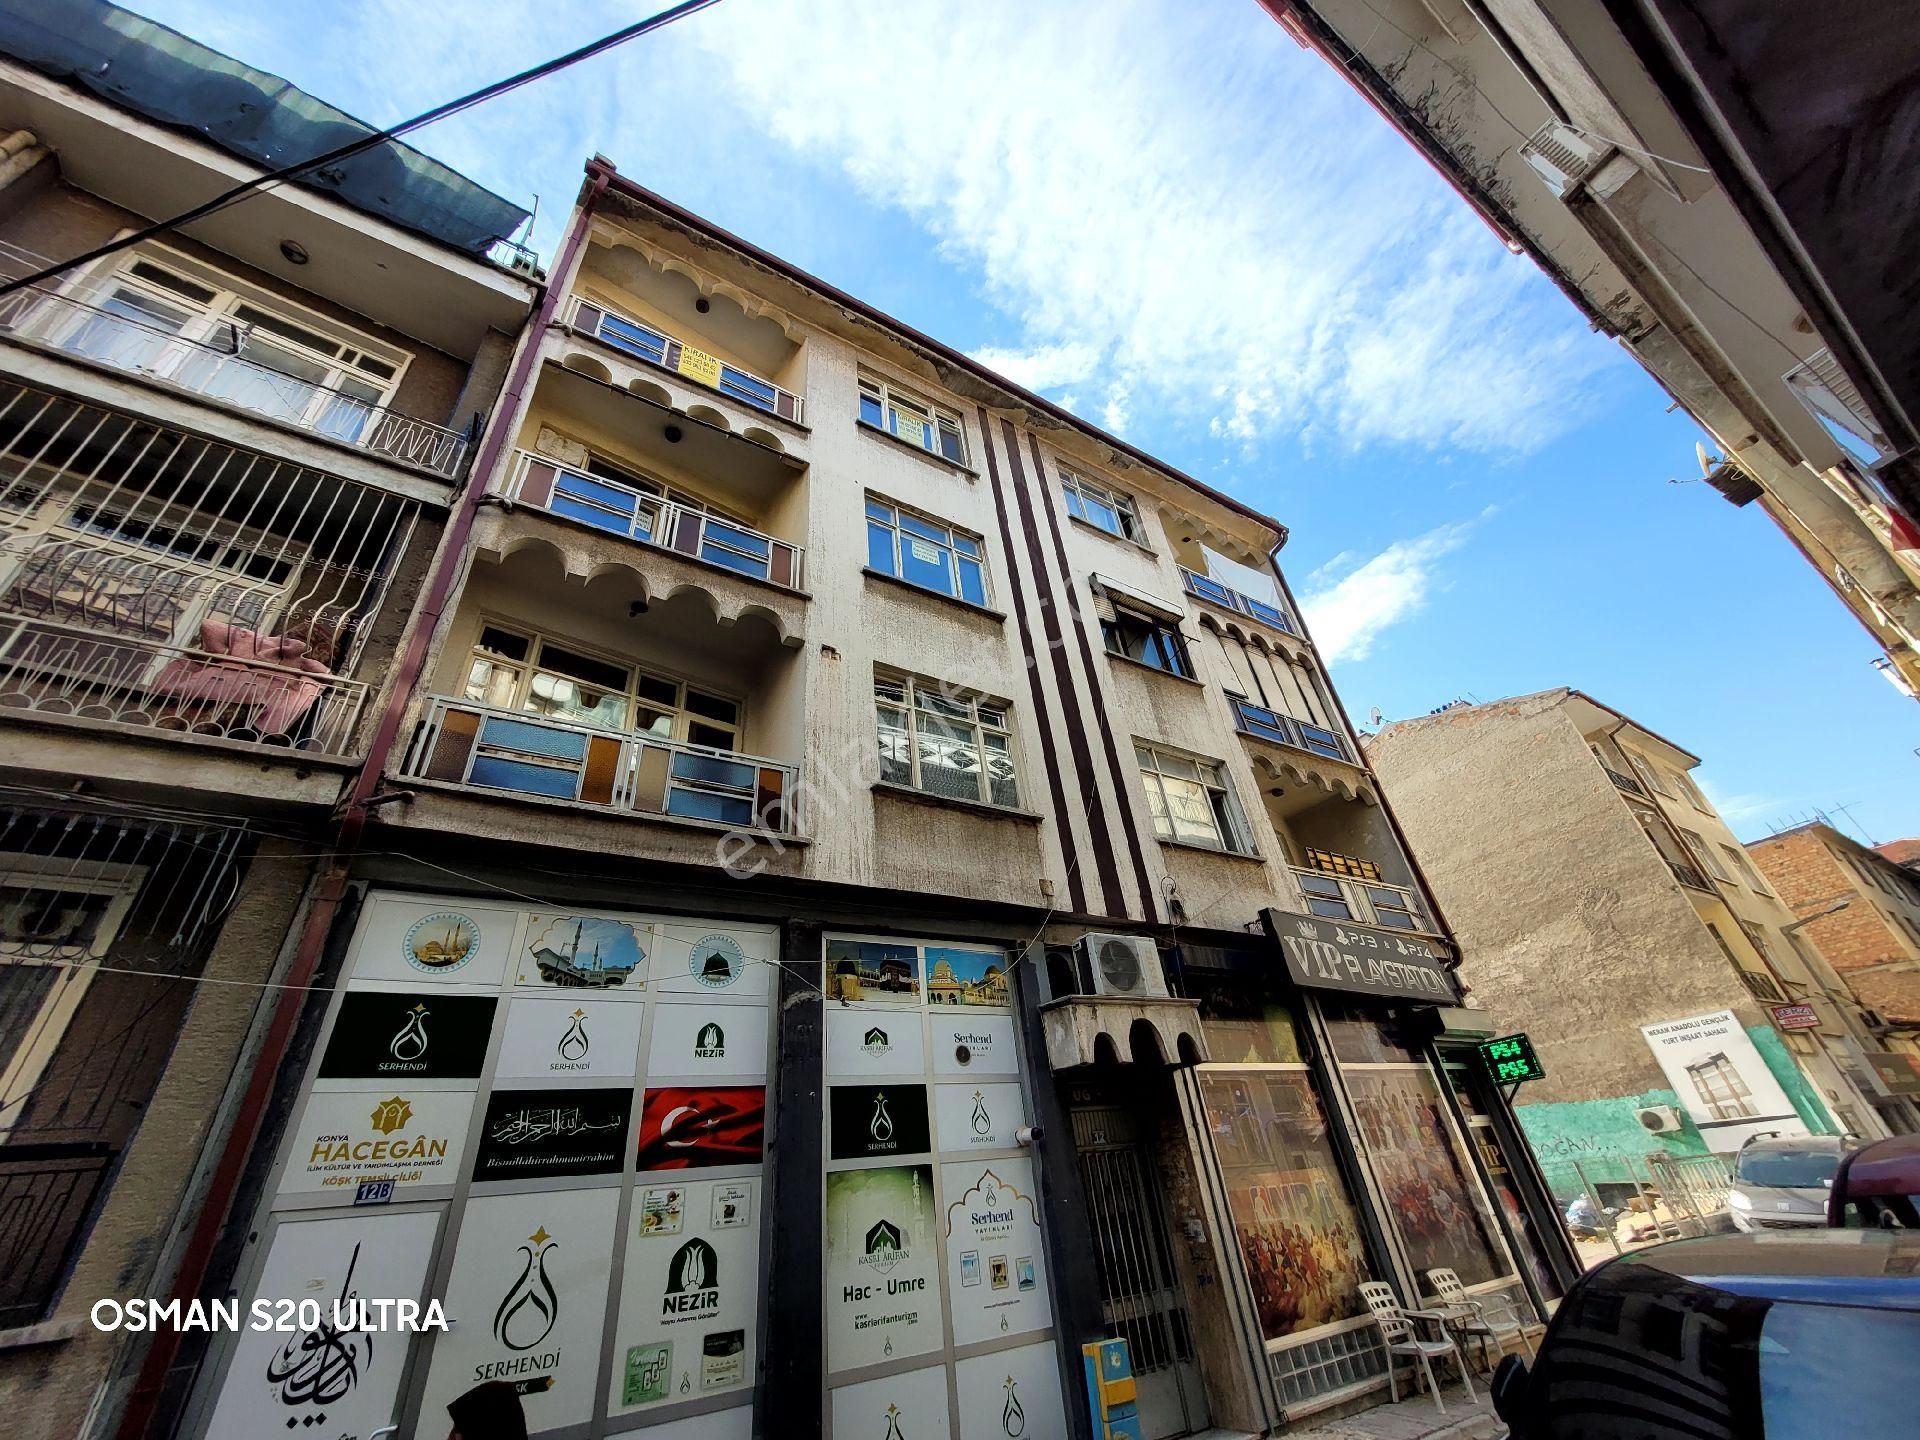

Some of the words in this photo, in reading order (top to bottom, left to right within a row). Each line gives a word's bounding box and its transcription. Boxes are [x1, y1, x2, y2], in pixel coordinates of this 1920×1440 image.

[1348, 932, 1378, 949] PS3
[1407, 943, 1434, 959] PS4
[1283, 935, 1343, 981] VIP
[1343, 953, 1452, 996] PLAYSTATION
[1671, 1021, 1701, 1032] ANADOLU
[953, 1033, 993, 1044] Serhend
[1662, 1036, 1679, 1045] YURT
[1490, 1041, 1521, 1059] PS4
[378, 1061, 427, 1071] SERHENDİ
[550, 1061, 590, 1070] SERHENDİ
[1498, 1059, 1529, 1078] PS5
[316, 1135, 349, 1143] KONYA
[309, 1134, 448, 1163] HACEGÂN
[867, 1141, 897, 1151] SERHENDİ
[324, 1163, 350, 1172] KÜLTÜR
[364, 1161, 411, 1169] YARDIMLAŞMA
[413, 1159, 443, 1167] DERNEĞİ
[322, 1176, 351, 1187] KÖŞK
[971, 1208, 1014, 1225] Serhend
[975, 1224, 1013, 1234] YAYINLARI
[843, 1285, 872, 1303] Hac
[887, 1277, 925, 1295] Umre
[473, 1347, 561, 1382] SERHENDİ
